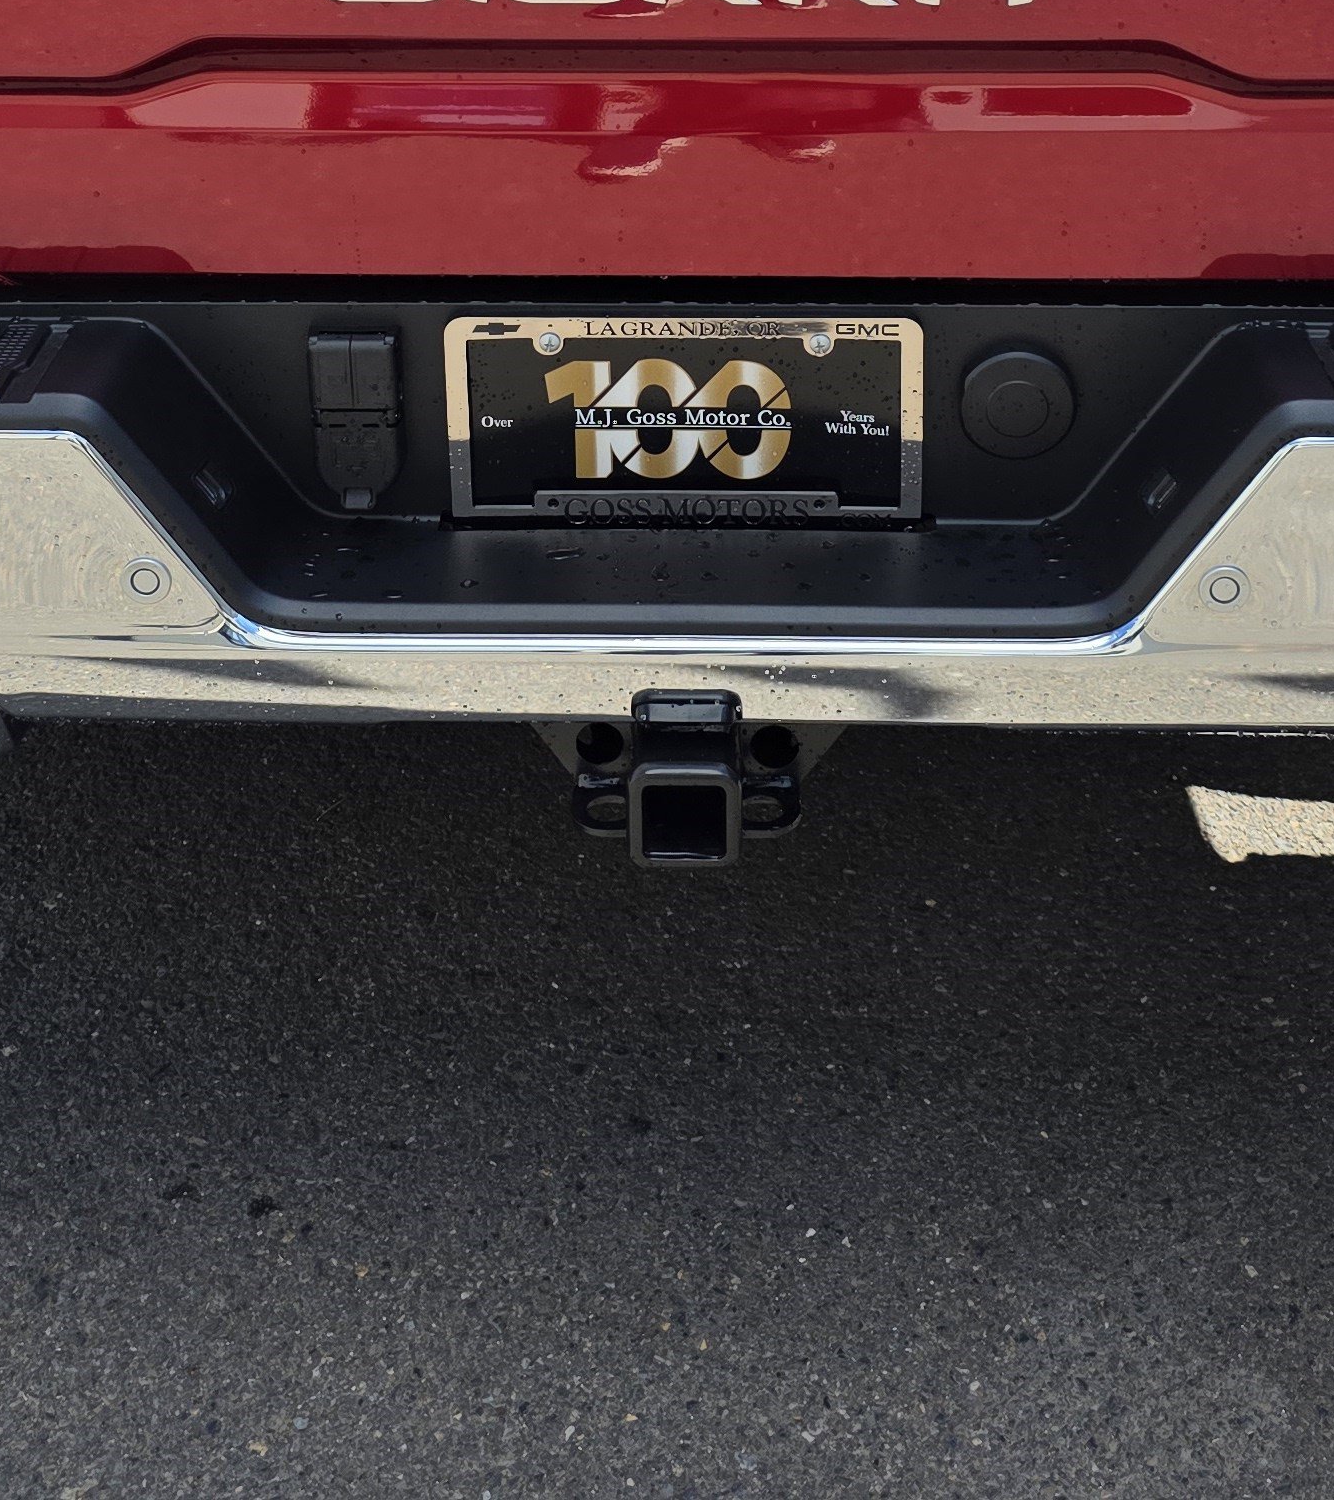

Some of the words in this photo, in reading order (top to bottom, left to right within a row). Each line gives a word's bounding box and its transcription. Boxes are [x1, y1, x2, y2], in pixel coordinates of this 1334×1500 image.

[746, 321, 782, 337] OR
[835, 323, 900, 337] GMC
[481, 415, 514, 428] Over
[544, 358, 792, 480] 100
[574, 408, 618, 426] M.J.
[626, 408, 677, 426] Goss
[684, 408, 751, 426] Motor
[757, 409, 792, 427] Co.
[840, 409, 875, 423] Years
[824, 422, 857, 435] With
[860, 423, 890, 437] You!
[564, 497, 653, 526] GOSS
[662, 497, 810, 526] MOTORS
